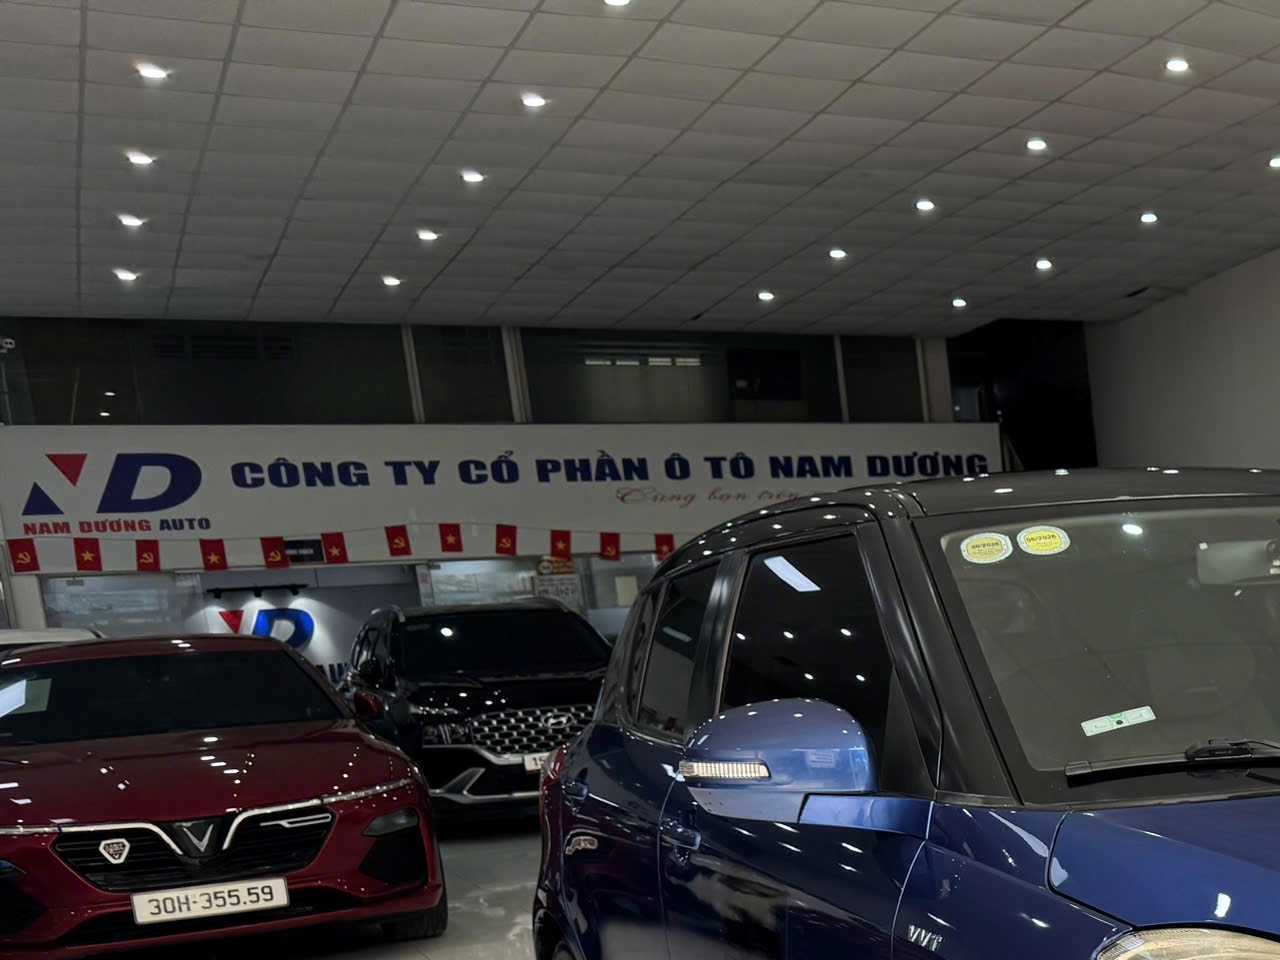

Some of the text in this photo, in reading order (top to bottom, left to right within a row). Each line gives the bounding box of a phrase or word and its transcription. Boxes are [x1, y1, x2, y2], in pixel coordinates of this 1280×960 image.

[230, 449, 989, 488] CÔNG TY CỔ PHẦN Ô TÔ NAM DƯƠNG
[23, 517, 212, 536] NAM DƯƠNG AUTO
[147, 884, 275, 917] 30H-355.59
